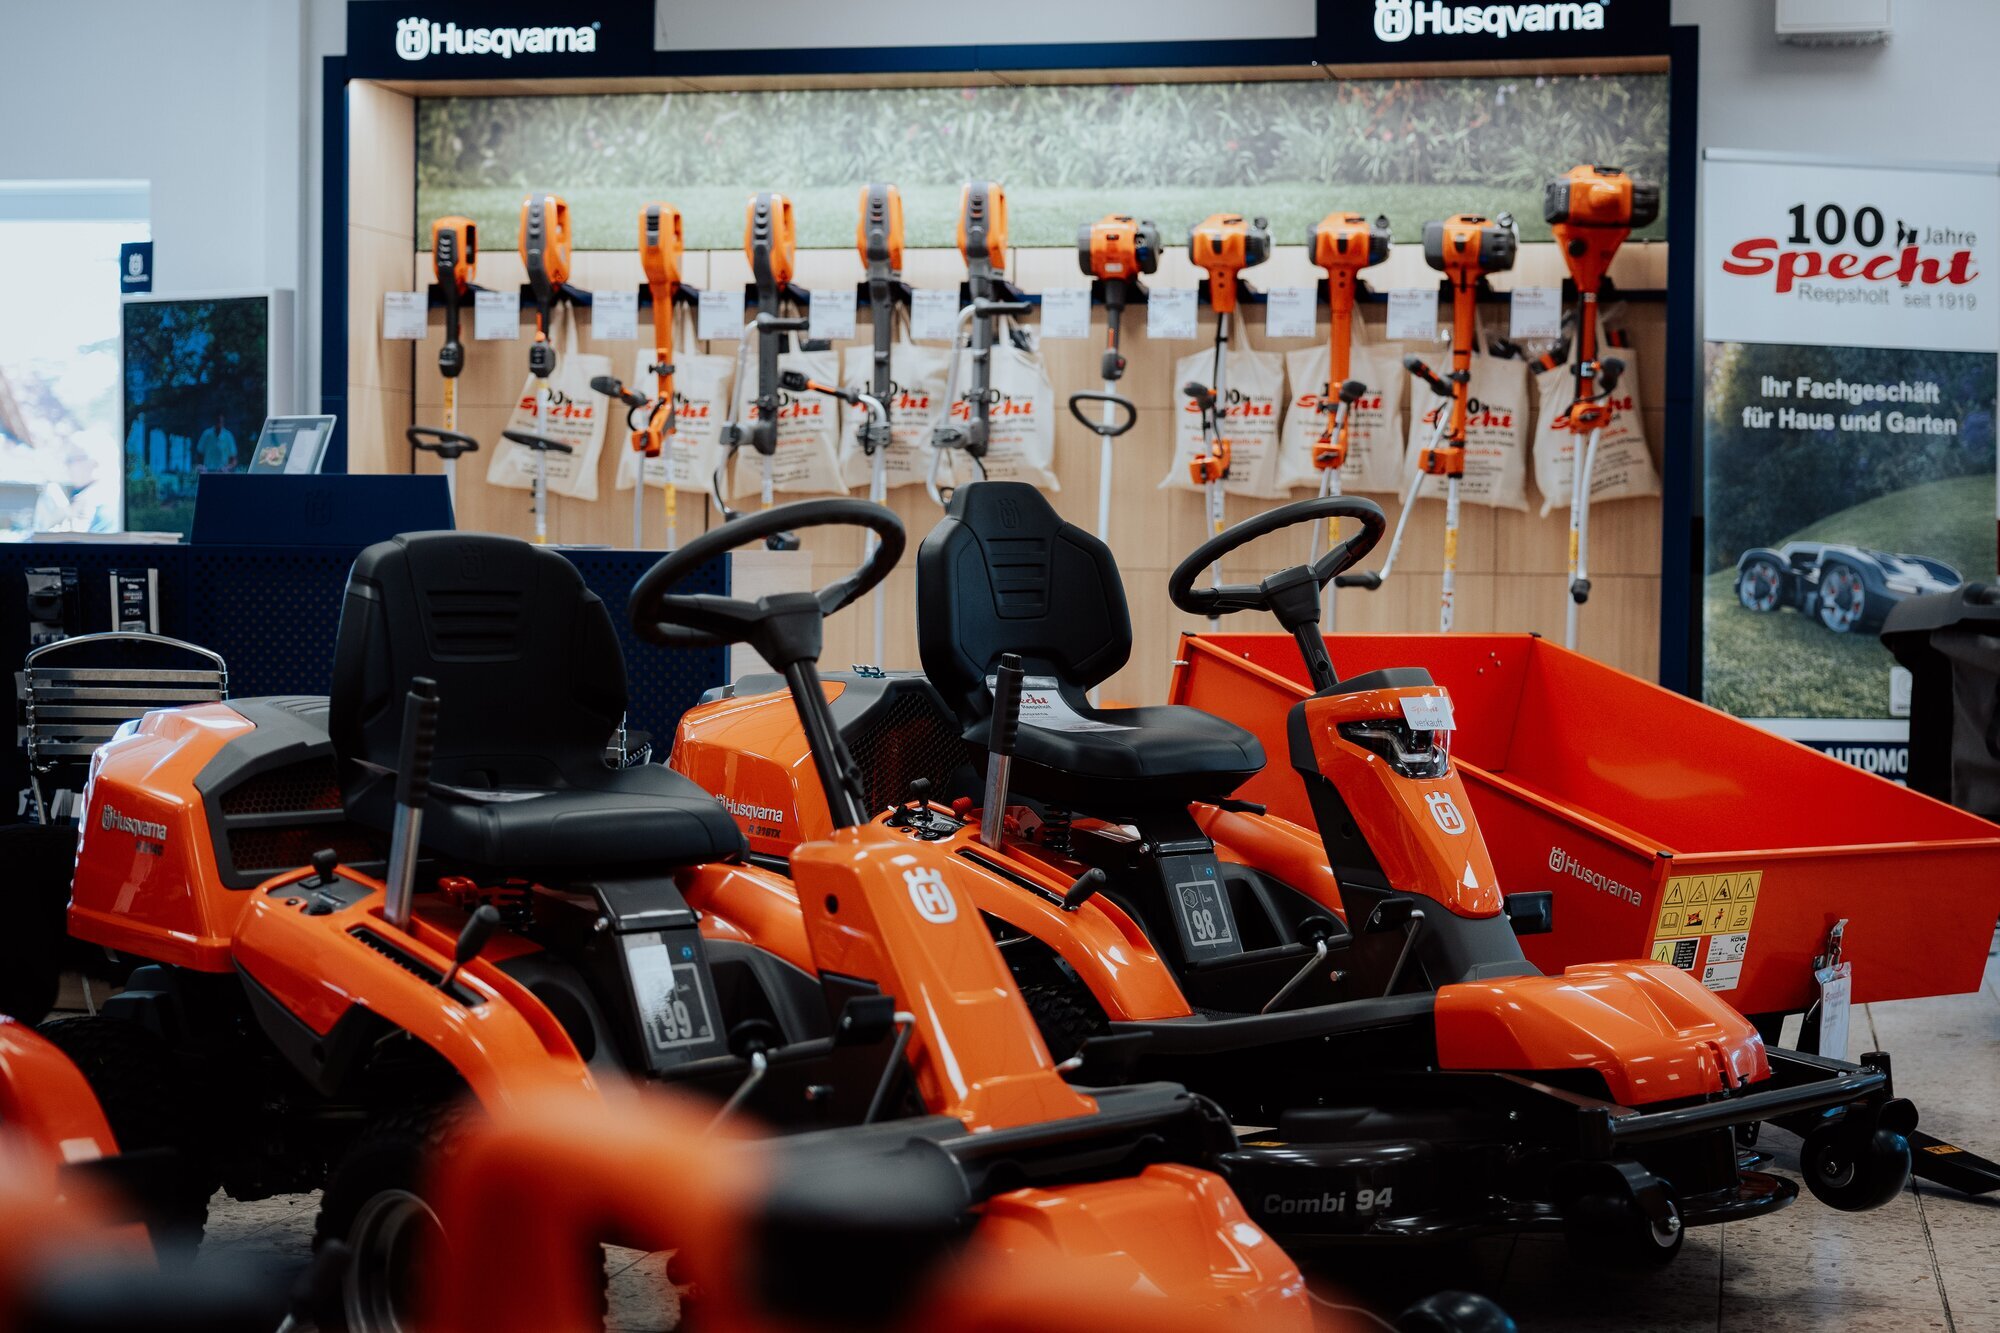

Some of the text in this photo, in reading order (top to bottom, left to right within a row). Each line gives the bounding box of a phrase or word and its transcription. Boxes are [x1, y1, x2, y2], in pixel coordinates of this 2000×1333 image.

[1414, 1, 1605, 38] Husqvarna
[431, 22, 596, 58] Husqvarna
[1788, 203, 1977, 248] 100 Jahre
[1722, 237, 1979, 294] Specht
[1798, 282, 1977, 311] Reepsholt seit 1919
[1761, 375, 1941, 405] Ihr Fachgeschäft
[1742, 406, 1958, 436] für Haus und Garten
[112, 810, 168, 841] Husqvarna
[727, 797, 784, 823] Husqvarna
[1564, 855, 1642, 907] Husqvarna
[1192, 908, 1217, 940] 98
[661, 1000, 693, 1040] 99
[1264, 1187, 1393, 1214] Combi 94
